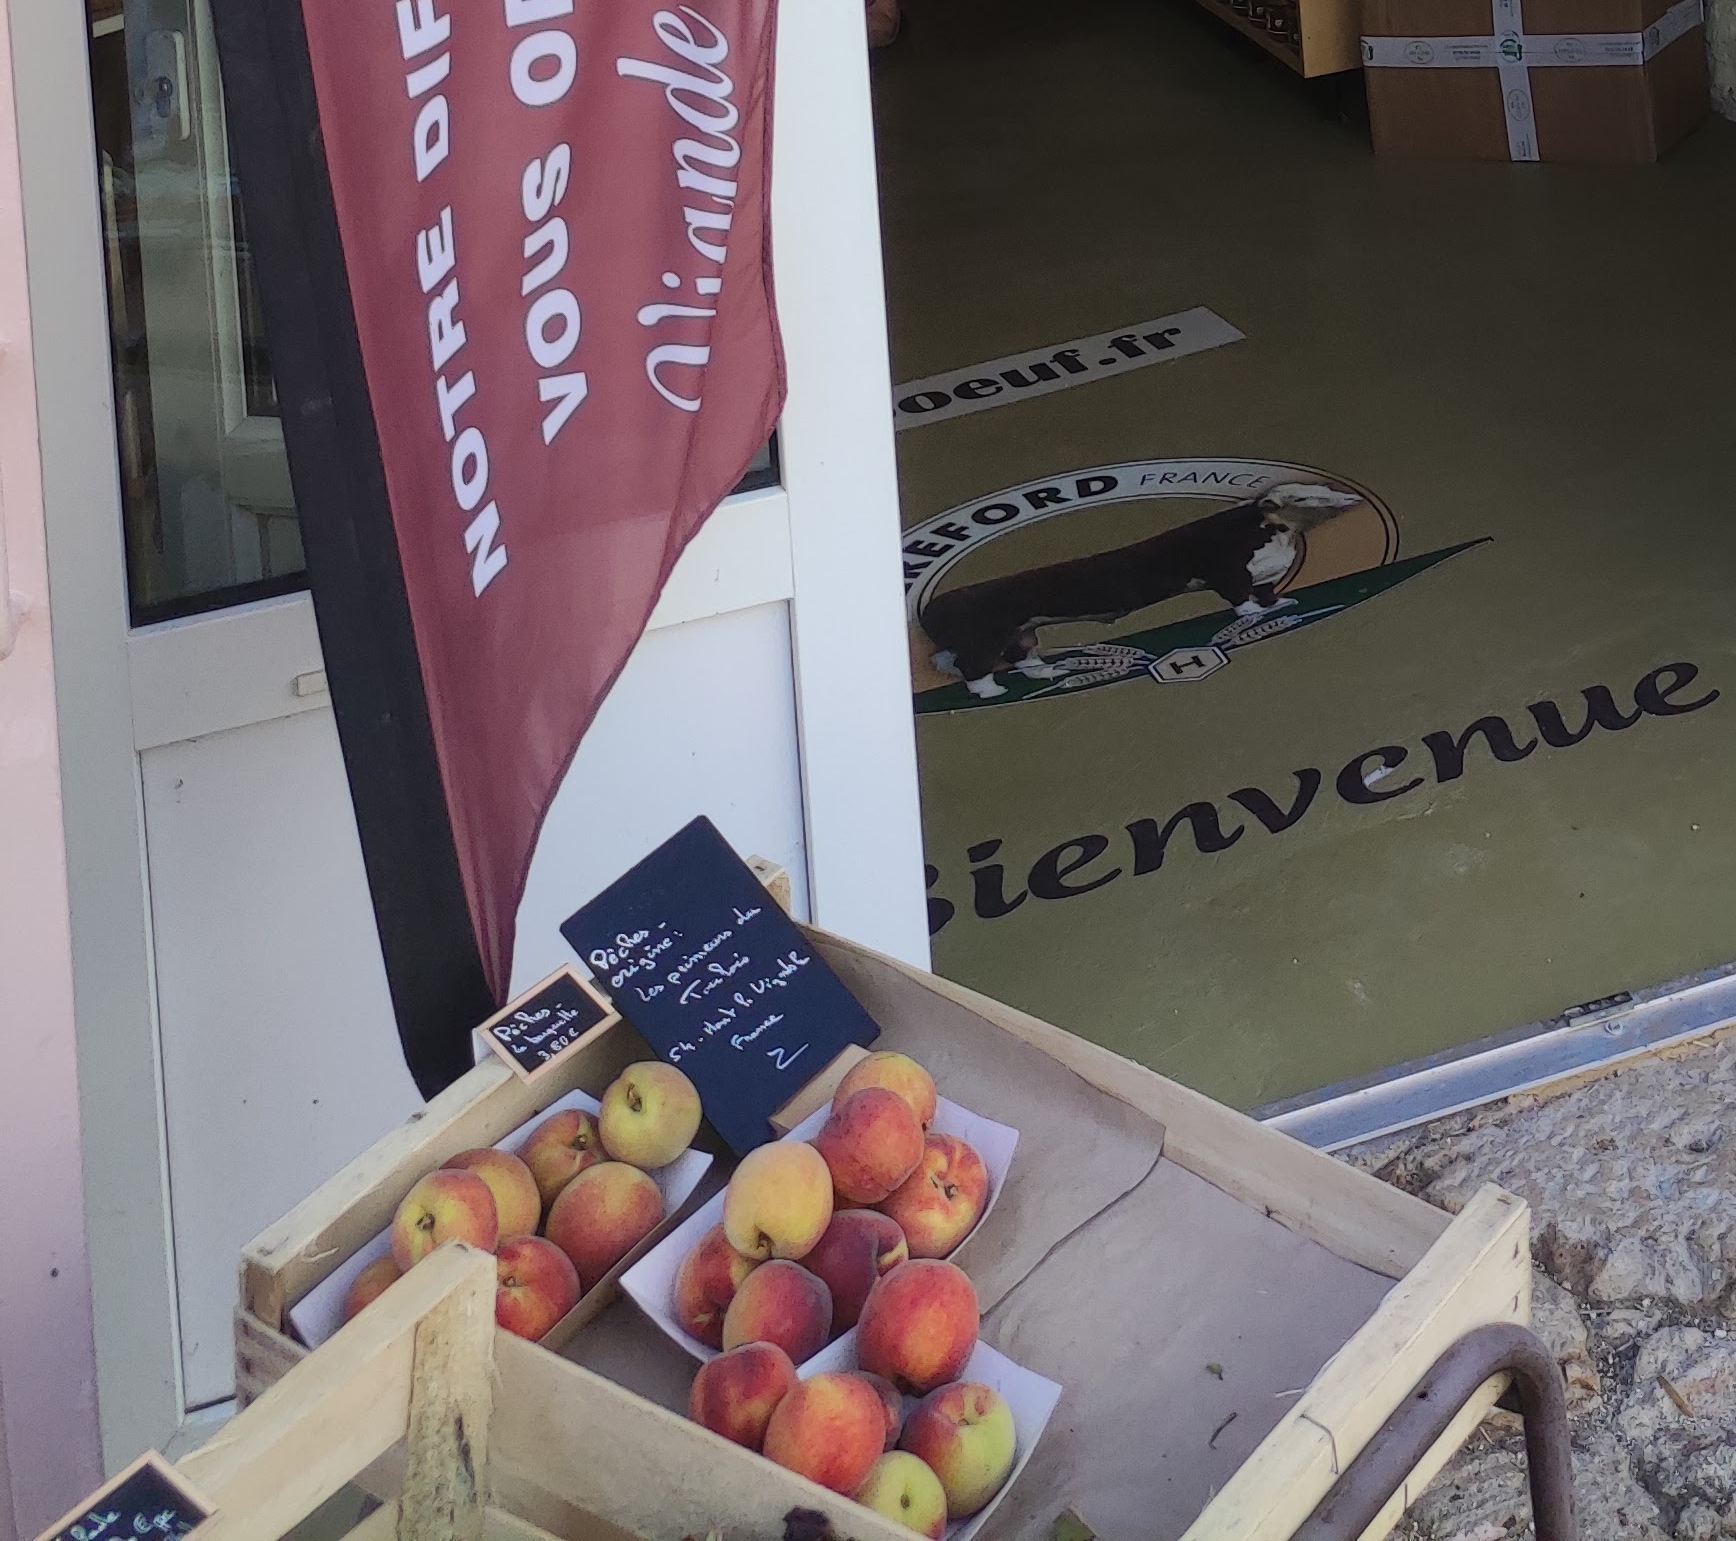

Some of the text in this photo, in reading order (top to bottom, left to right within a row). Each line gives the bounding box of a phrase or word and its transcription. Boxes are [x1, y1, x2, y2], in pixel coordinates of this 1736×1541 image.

[520, 142, 591, 447] VOUS
[614, 4, 744, 413] Viande
[416, 204, 510, 599] NOTRE
[894, 324, 1184, 419] oeuf.fr
[1138, 470, 1272, 492] FRANCE
